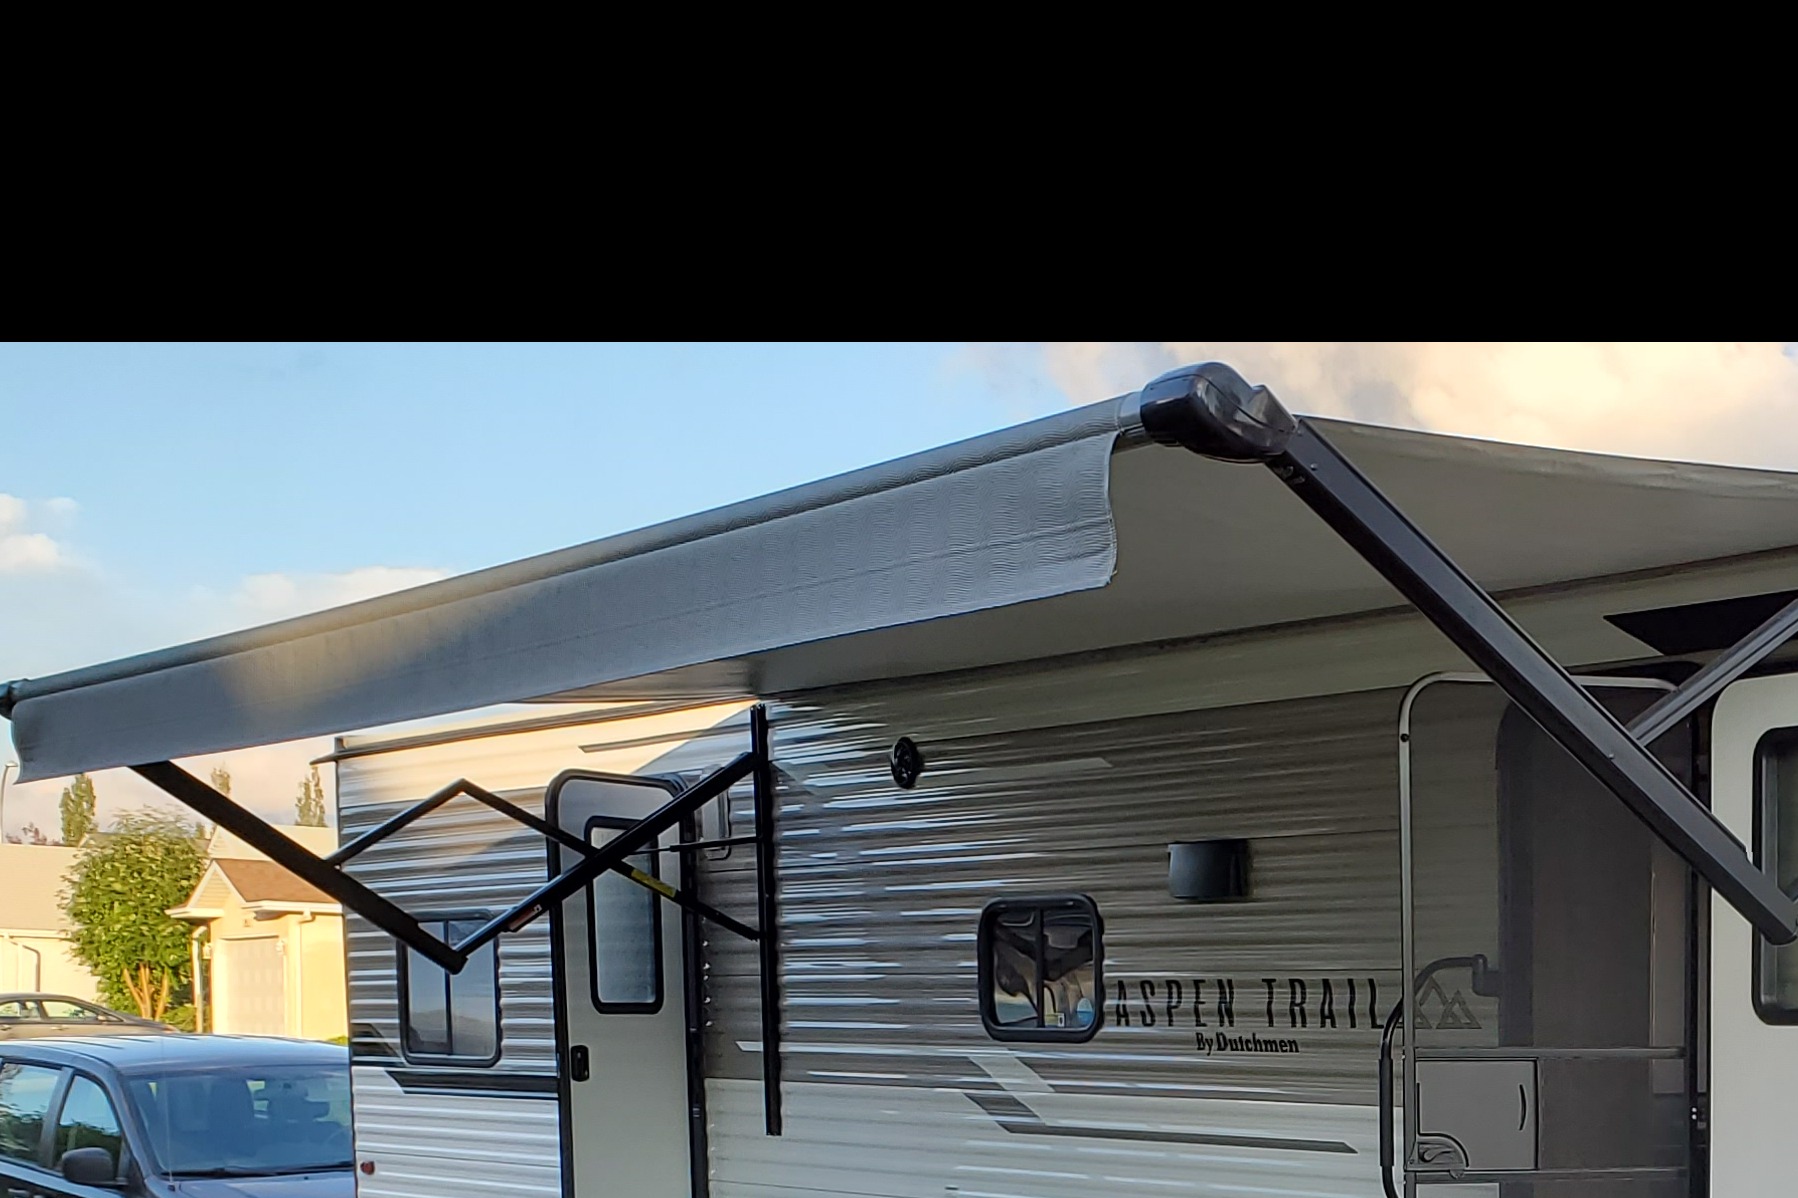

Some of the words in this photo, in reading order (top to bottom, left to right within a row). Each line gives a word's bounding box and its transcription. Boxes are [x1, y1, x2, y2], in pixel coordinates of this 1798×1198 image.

[1115, 978, 1235, 1028] ASPEN
[1262, 978, 1385, 1029] TRAIL
[1195, 1031, 1214, 1056] By
[1216, 1031, 1300, 1053] Dutchmen
